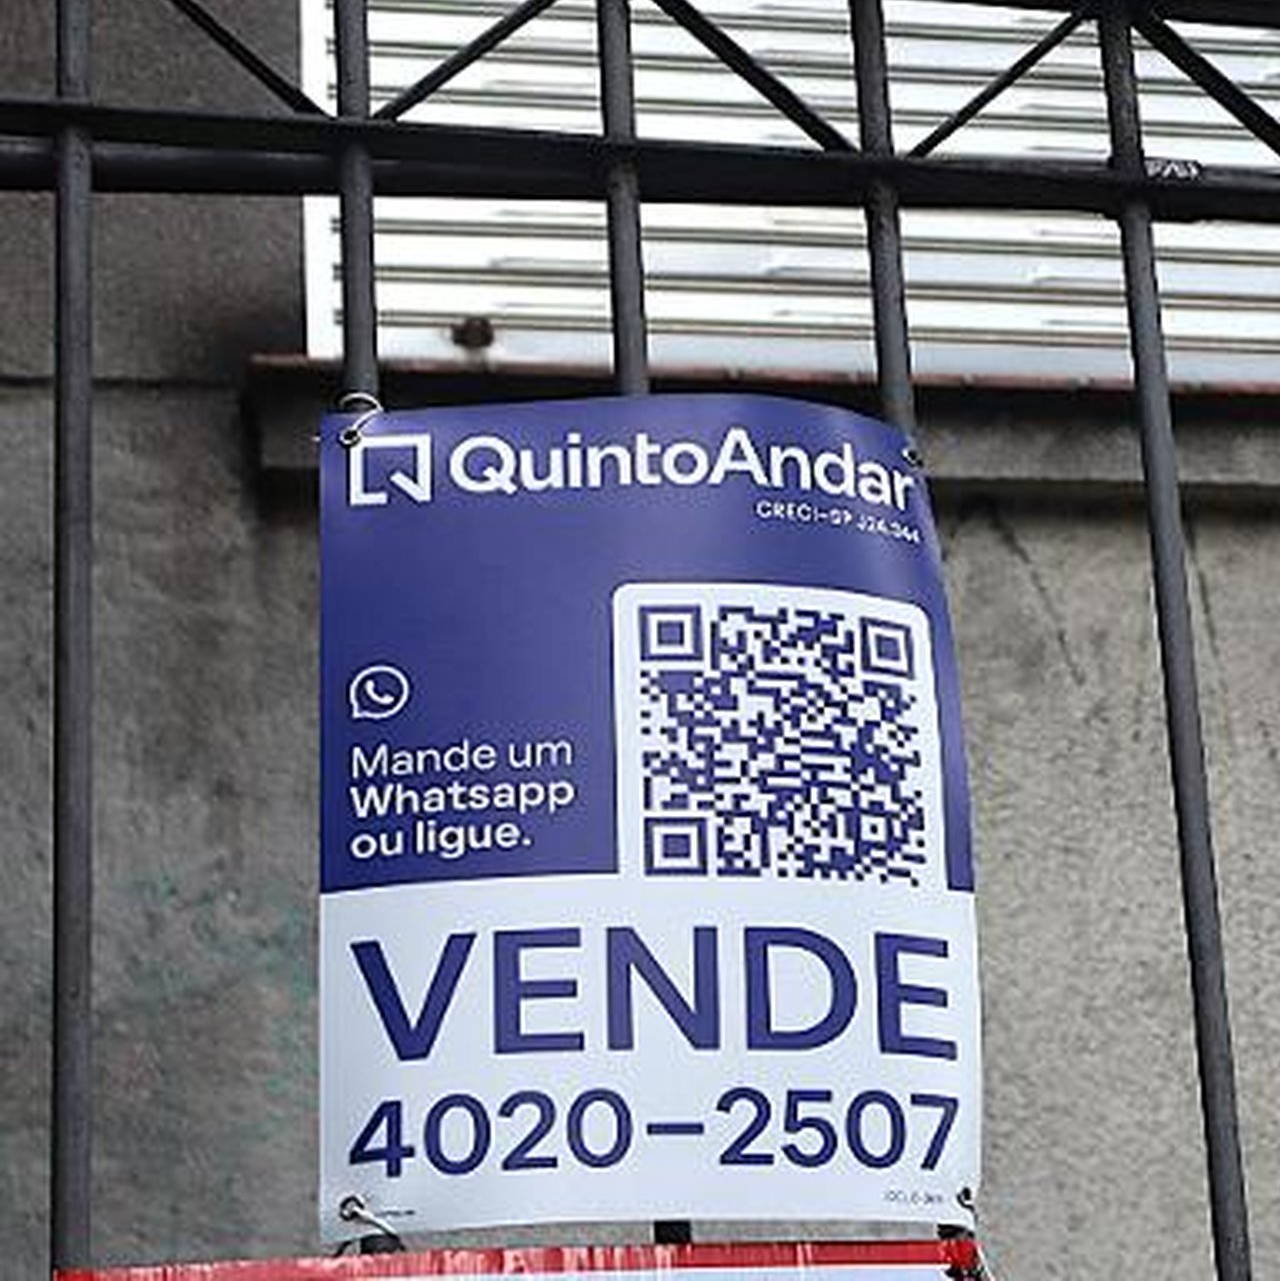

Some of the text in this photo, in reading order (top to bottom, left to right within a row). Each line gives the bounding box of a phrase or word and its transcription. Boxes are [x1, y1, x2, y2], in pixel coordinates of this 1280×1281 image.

[448, 427, 916, 511] QuintoAndar
[350, 737, 573, 779] Mande um
[350, 776, 576, 819] Whatsapp
[350, 817, 532, 860] ou ligue.
[350, 925, 959, 1062] VENDE
[348, 1086, 960, 1179] 4020-2507
